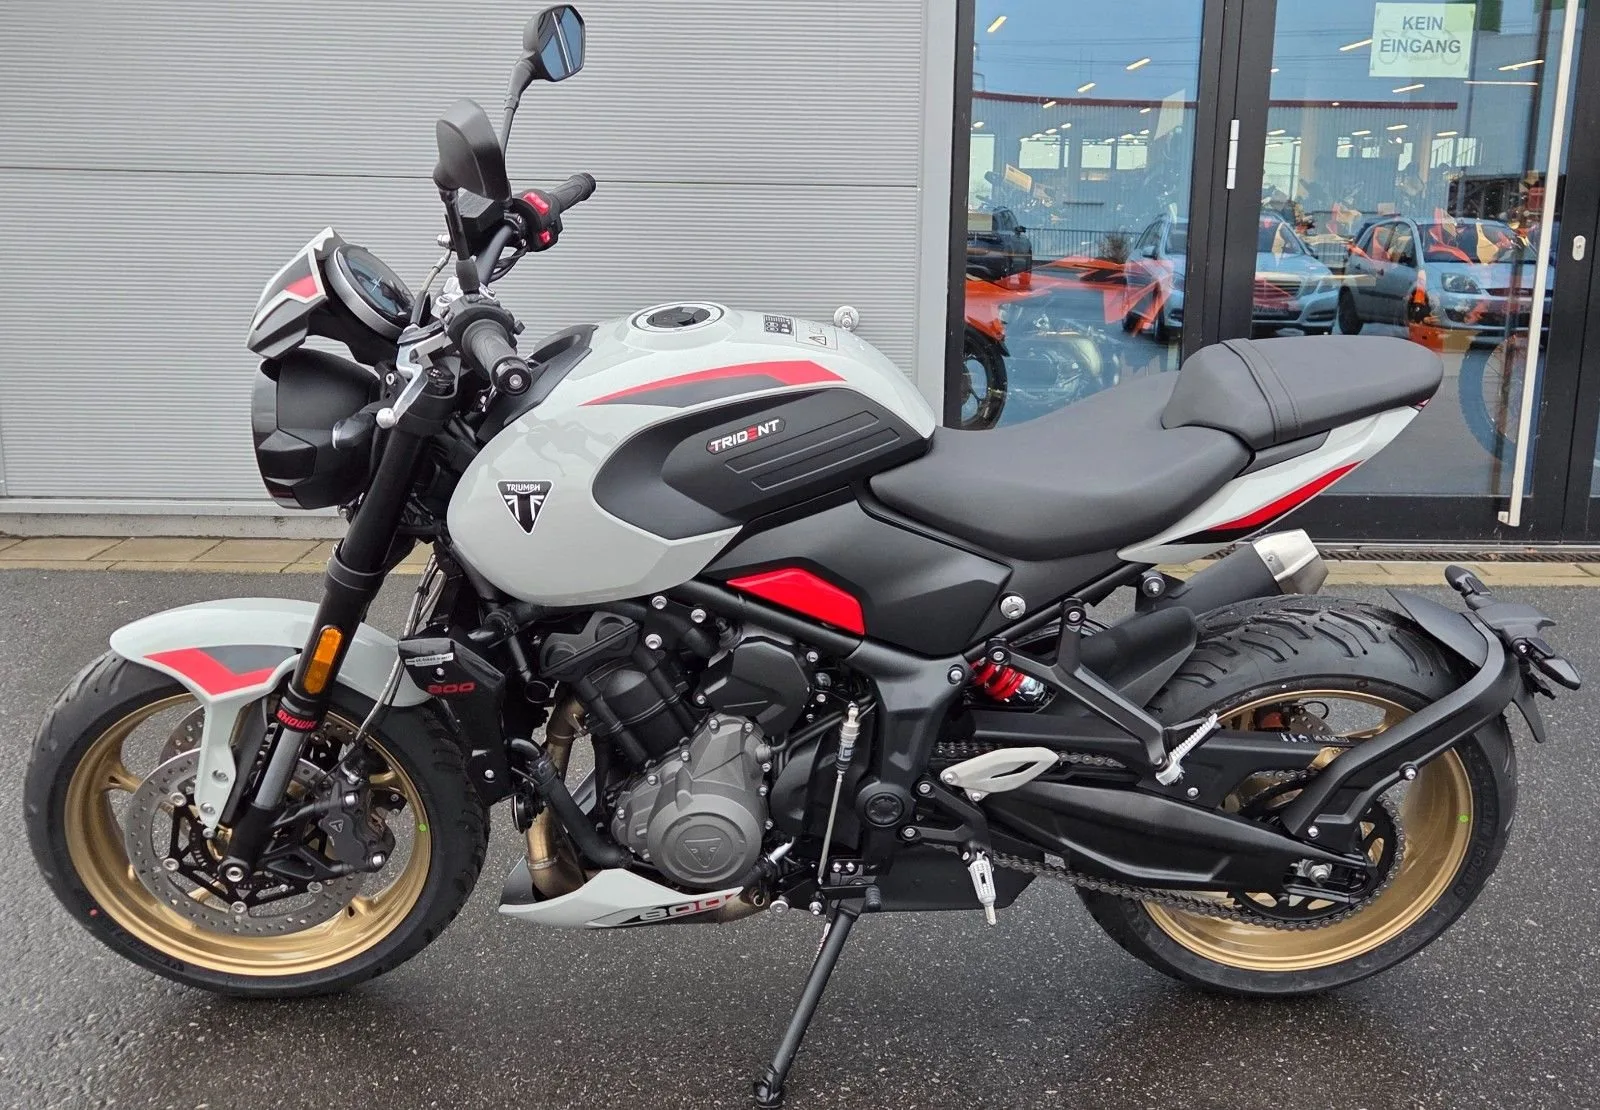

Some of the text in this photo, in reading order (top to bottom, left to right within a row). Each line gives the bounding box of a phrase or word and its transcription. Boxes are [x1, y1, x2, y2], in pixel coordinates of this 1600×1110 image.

[1402, 16, 1443, 30] KEIN
[1380, 38, 1461, 53] EINGANG
[710, 418, 780, 452] TRIDENT
[506, 483, 541, 493] TRIUMPH
